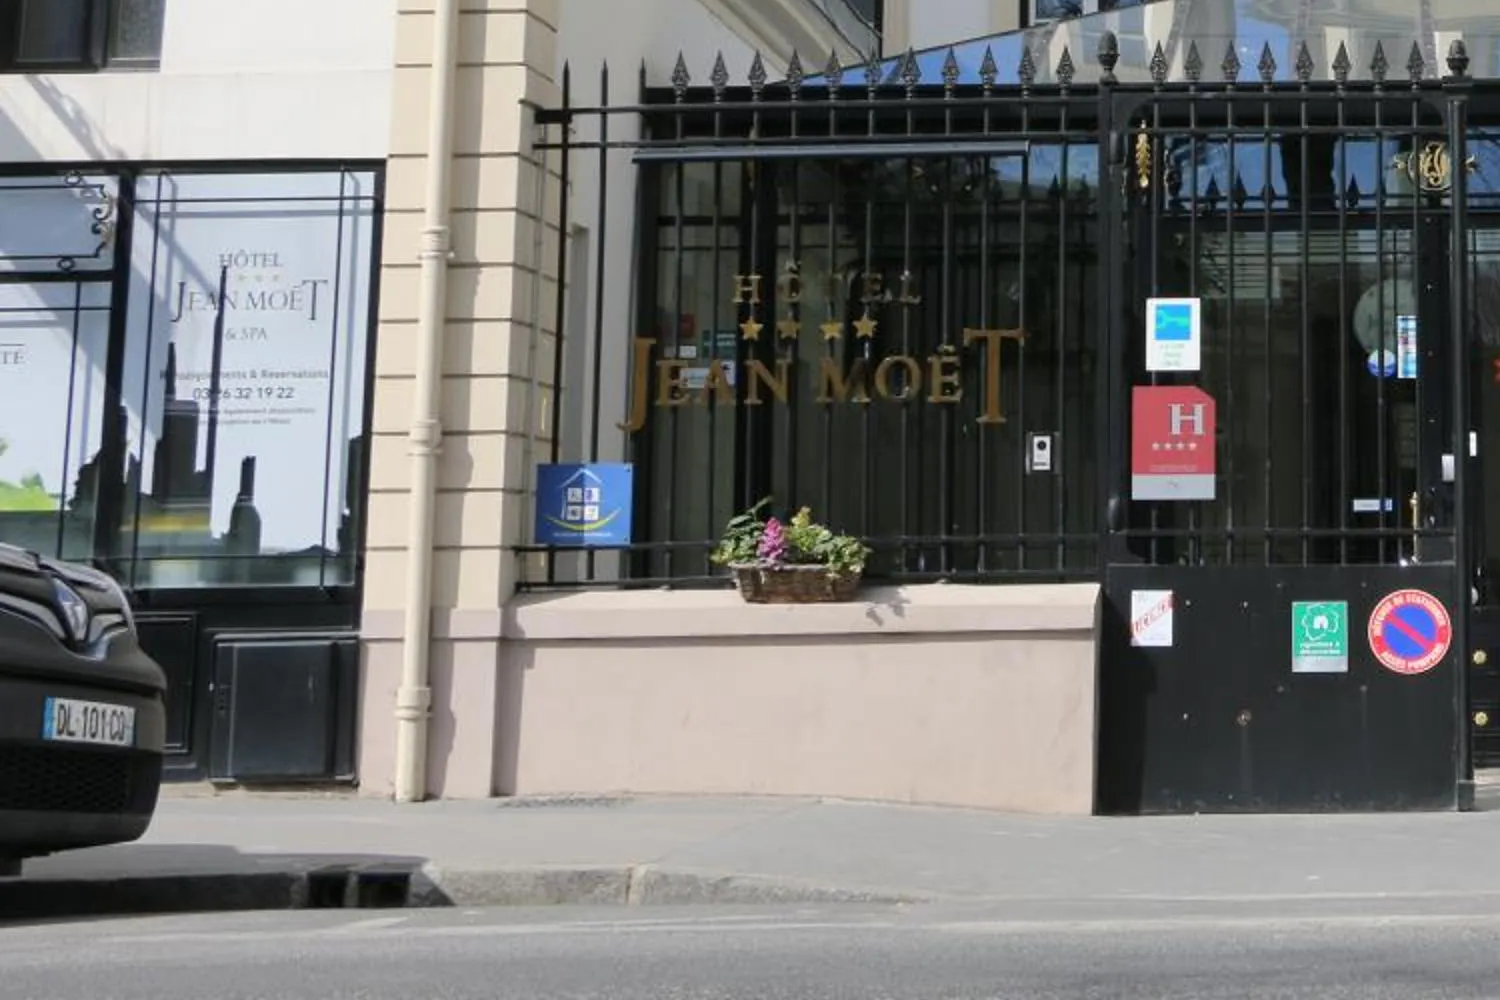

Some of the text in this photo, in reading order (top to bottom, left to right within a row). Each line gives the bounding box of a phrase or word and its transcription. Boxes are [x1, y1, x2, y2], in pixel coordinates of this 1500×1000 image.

[219, 249, 283, 268] HÔTEL
[169, 281, 238, 322] JEAN
[240, 327, 268, 340] SPA
[616, 336, 795, 432] JEAN
[1168, 403, 1206, 436] H
